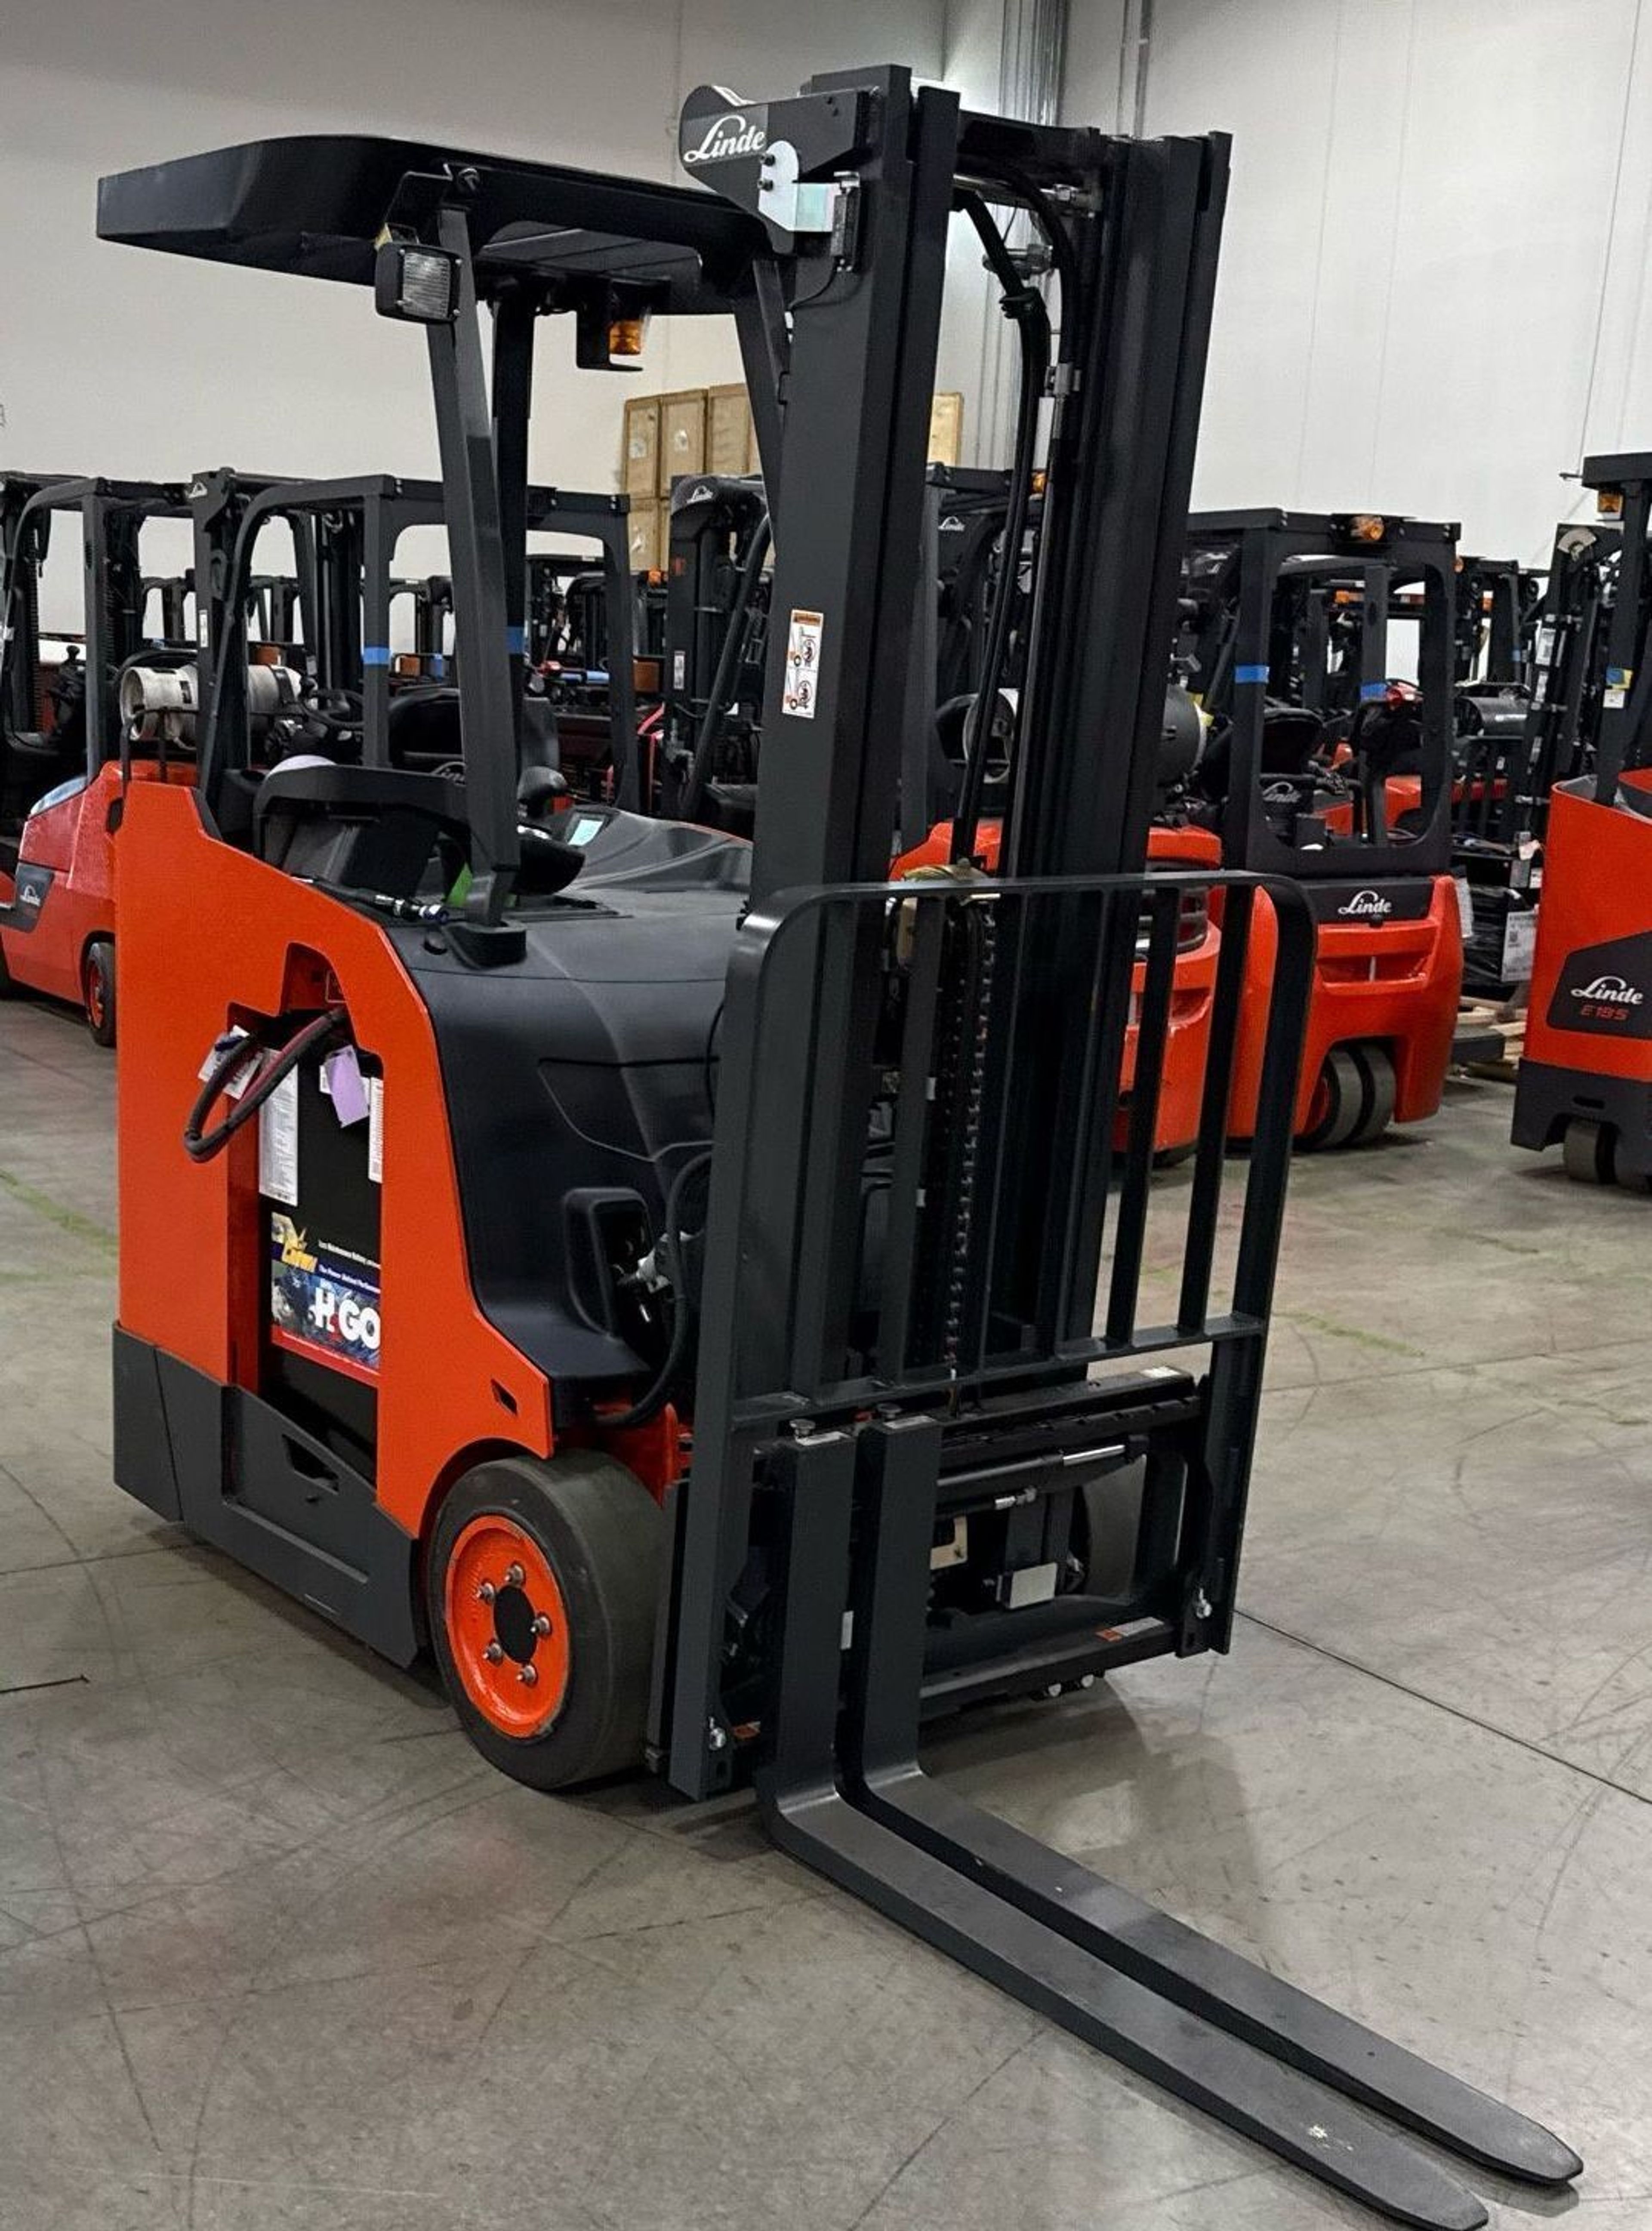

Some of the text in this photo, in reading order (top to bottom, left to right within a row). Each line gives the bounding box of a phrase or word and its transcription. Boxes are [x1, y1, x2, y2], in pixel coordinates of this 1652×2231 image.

[684, 114, 764, 162] Linde
[1338, 891, 1392, 915] Linde
[1571, 976, 1643, 1005] Linde
